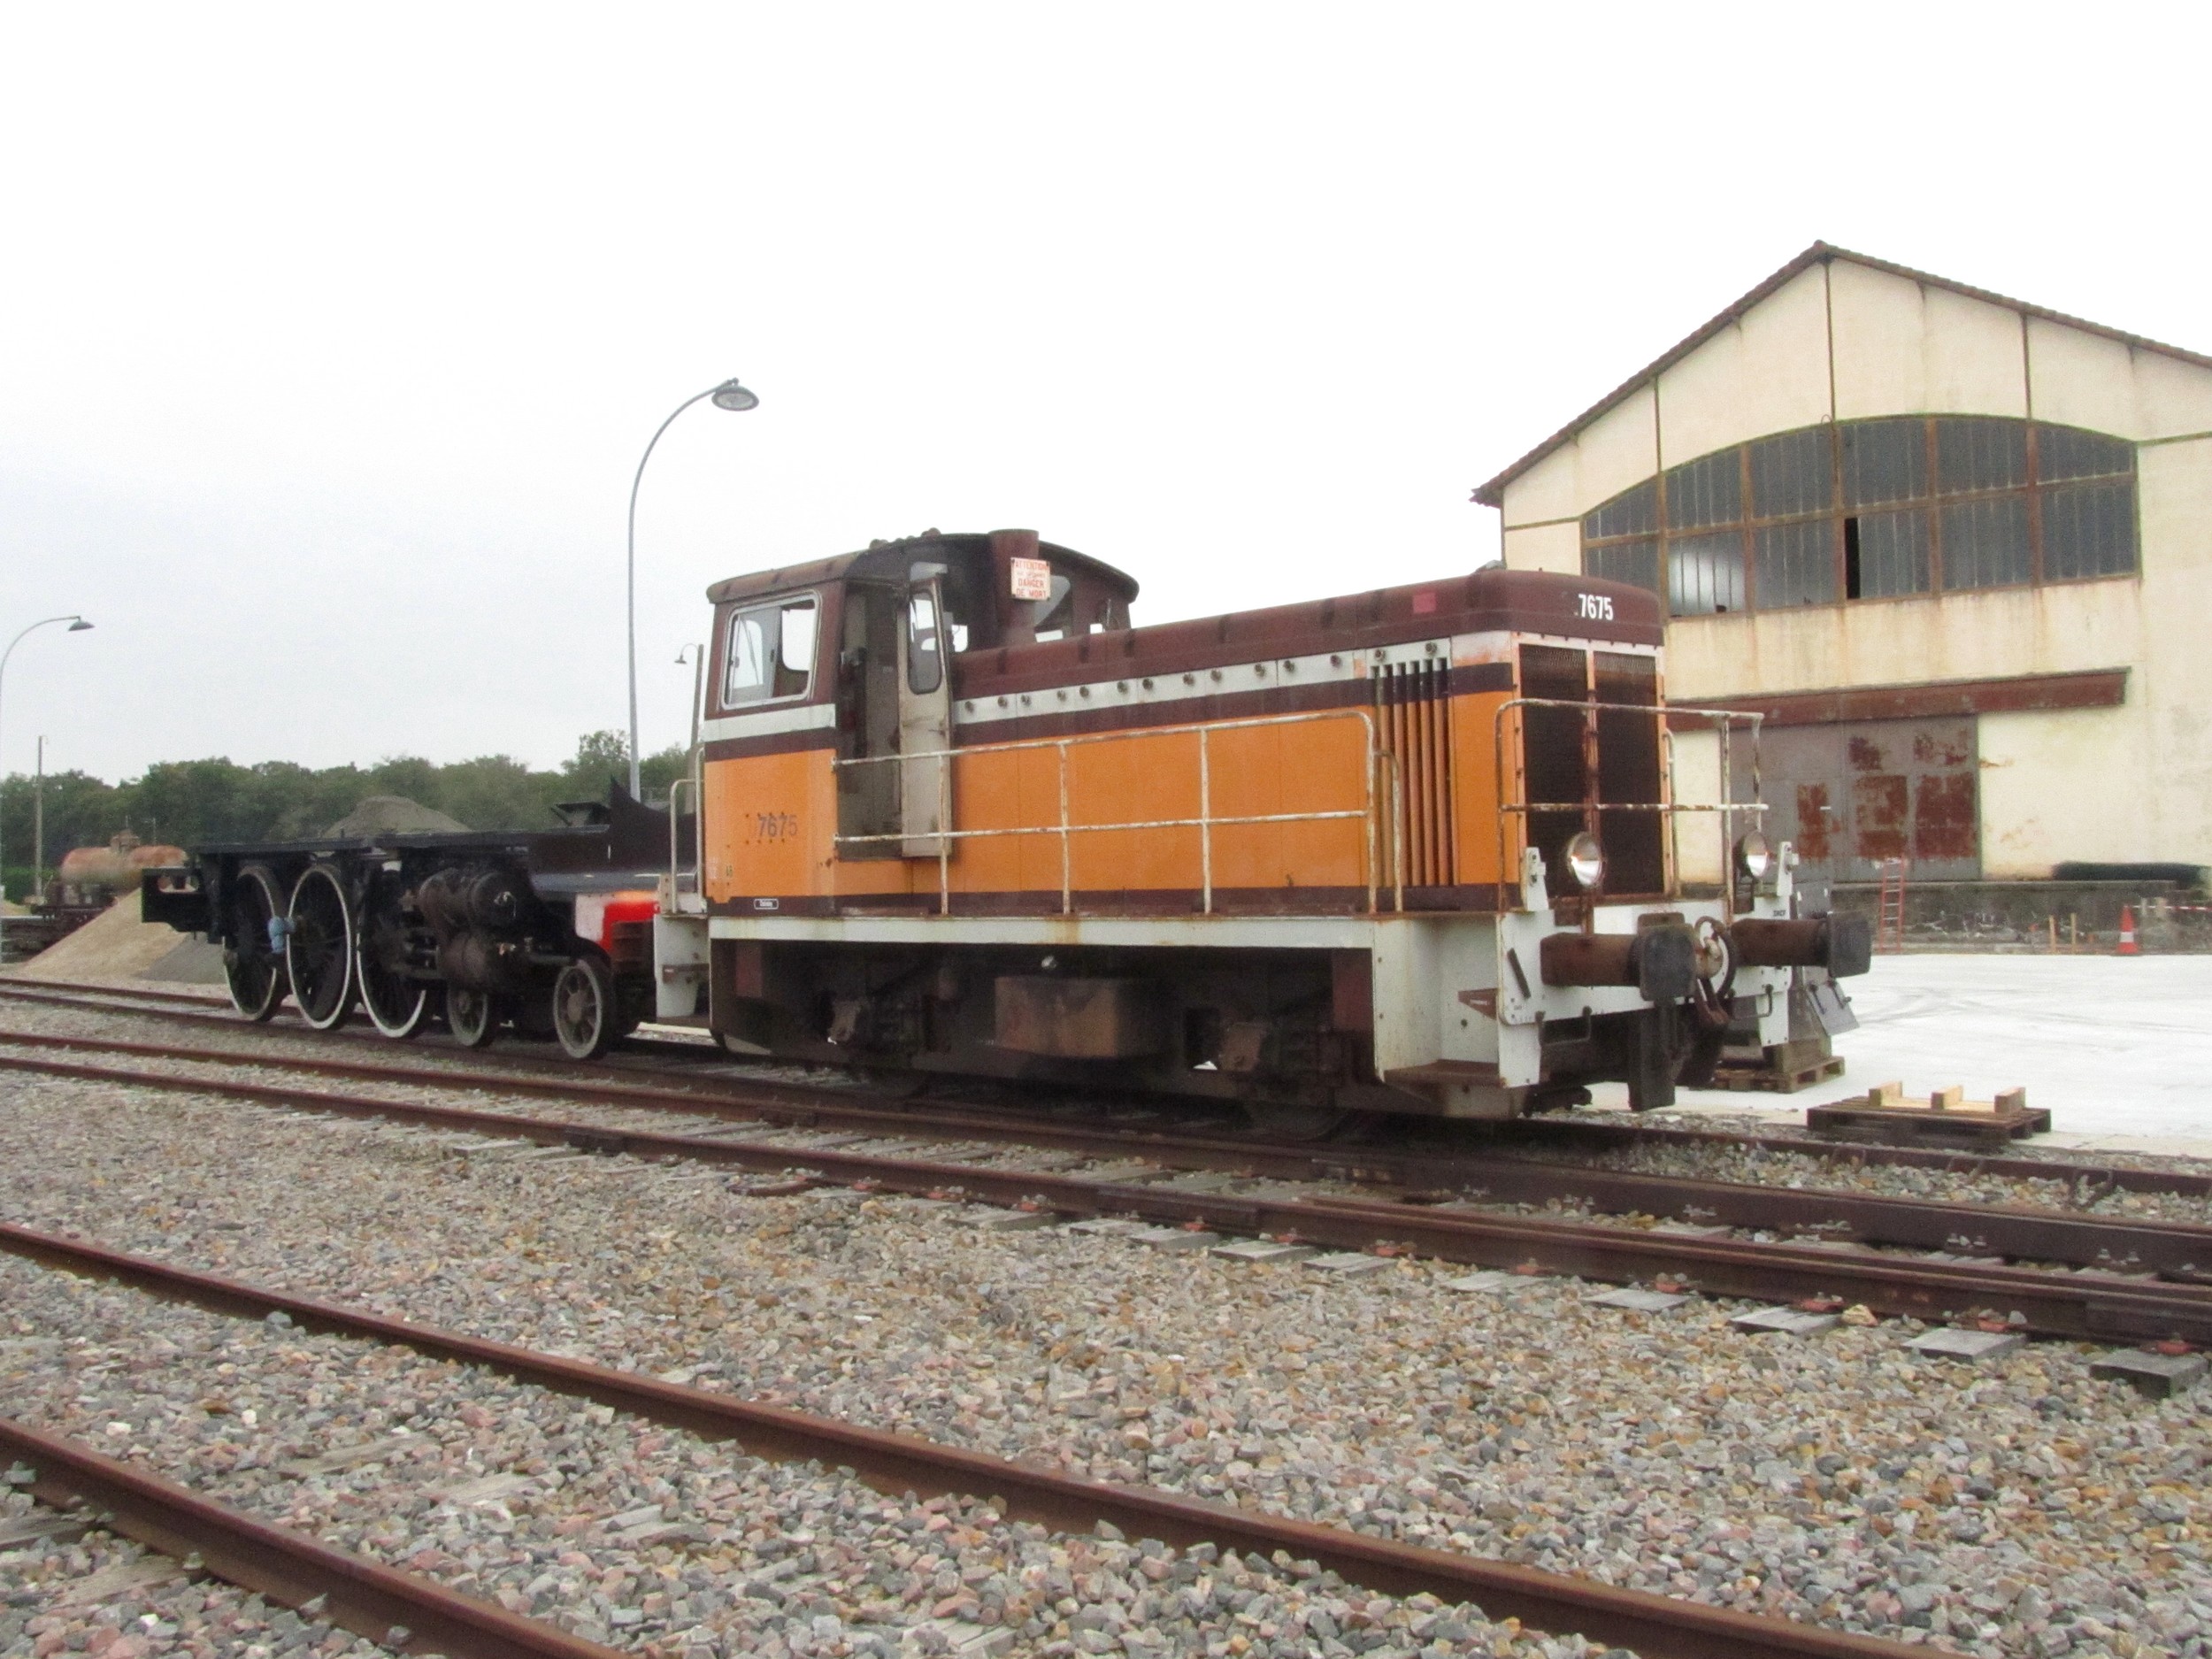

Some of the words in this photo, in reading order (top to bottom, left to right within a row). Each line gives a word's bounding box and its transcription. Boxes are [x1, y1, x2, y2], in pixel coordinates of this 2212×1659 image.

[1018, 578, 1045, 588] DANGER
[1578, 594, 1614, 621] 7675
[757, 814, 798, 837] 7675
